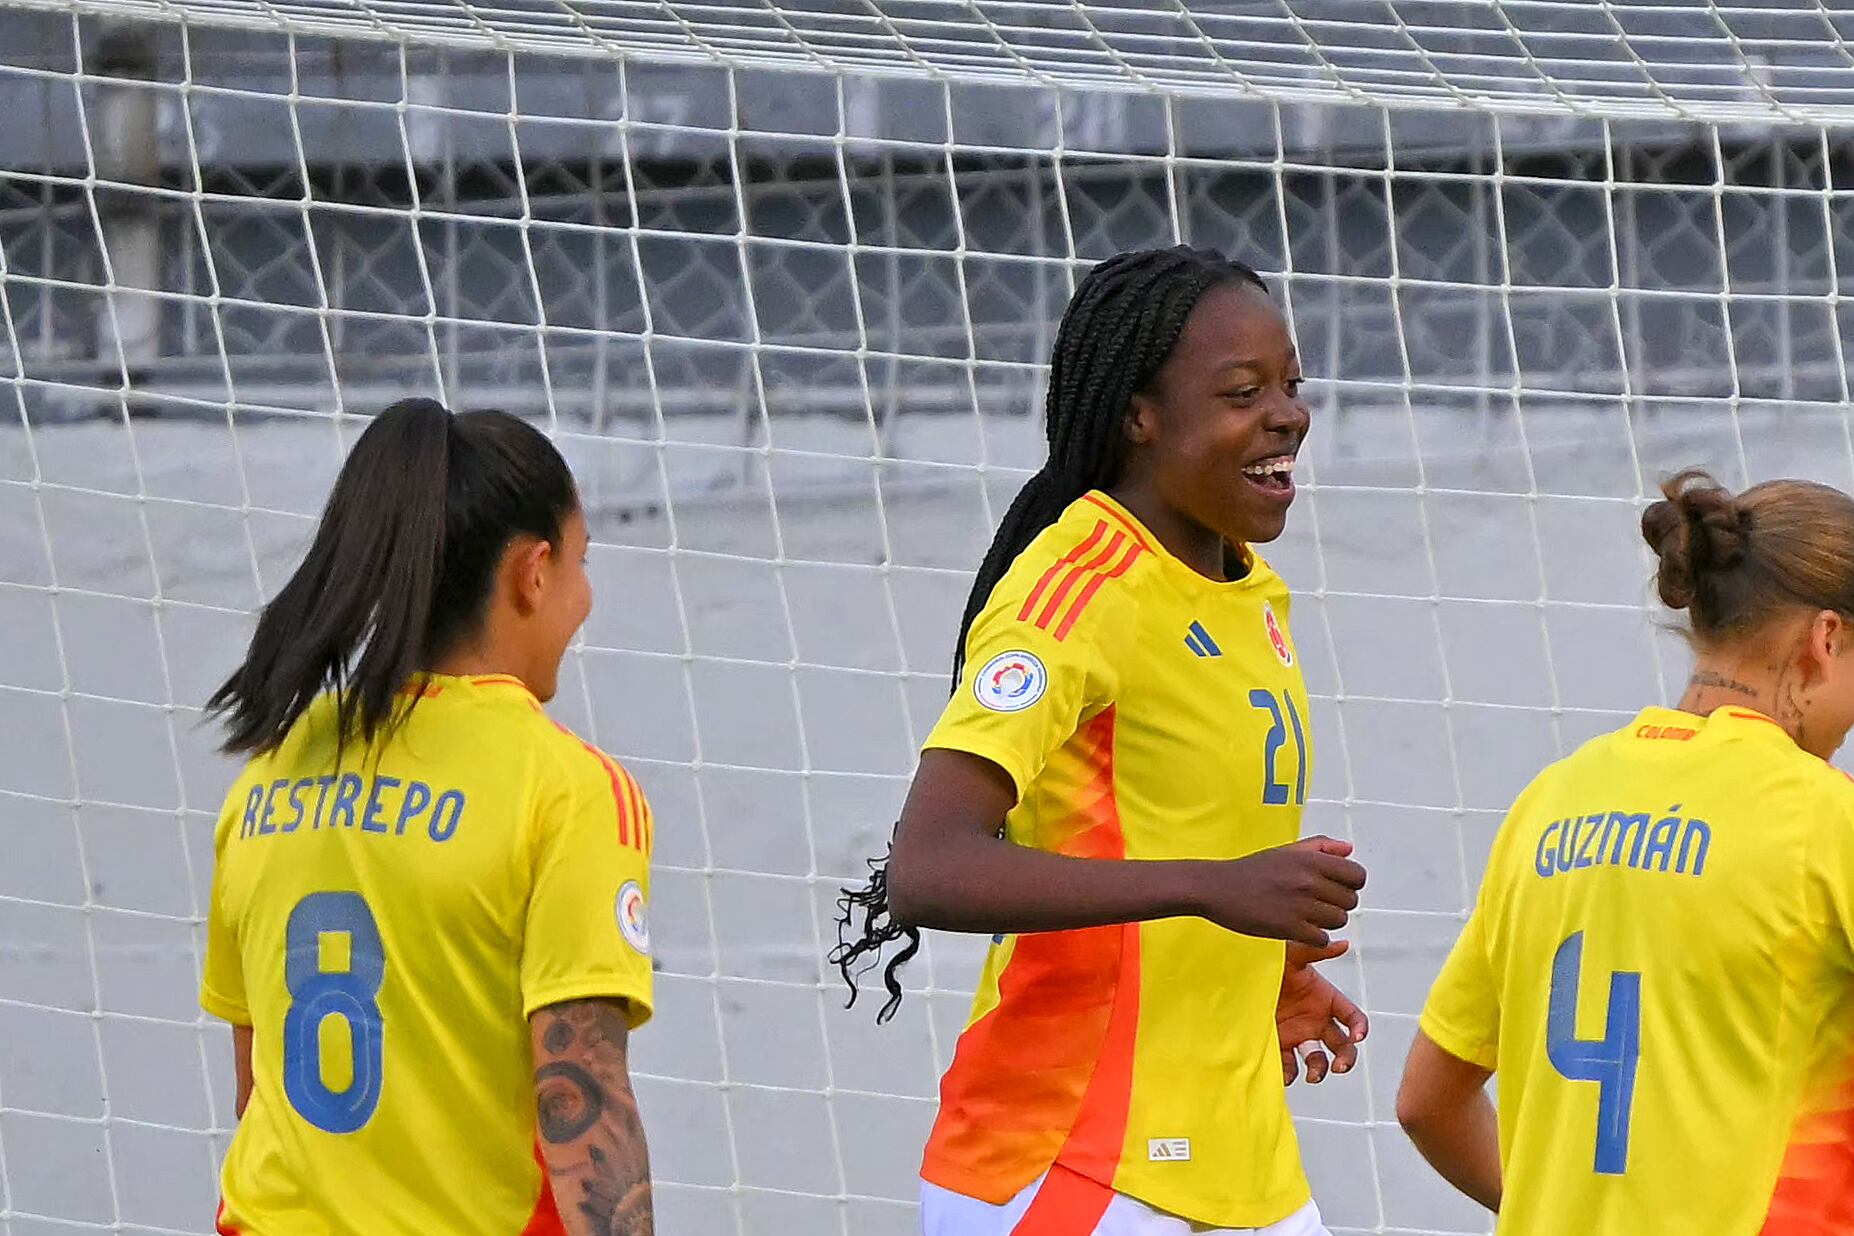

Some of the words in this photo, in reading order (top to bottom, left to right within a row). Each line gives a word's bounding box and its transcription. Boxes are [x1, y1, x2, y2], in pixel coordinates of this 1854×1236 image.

[1248, 688, 1304, 806] 21
[241, 773, 465, 842] RESTREPO
[1536, 805, 1711, 877] GUZMÁN
[284, 891, 385, 1133] 8
[1546, 930, 1642, 1175] 4
